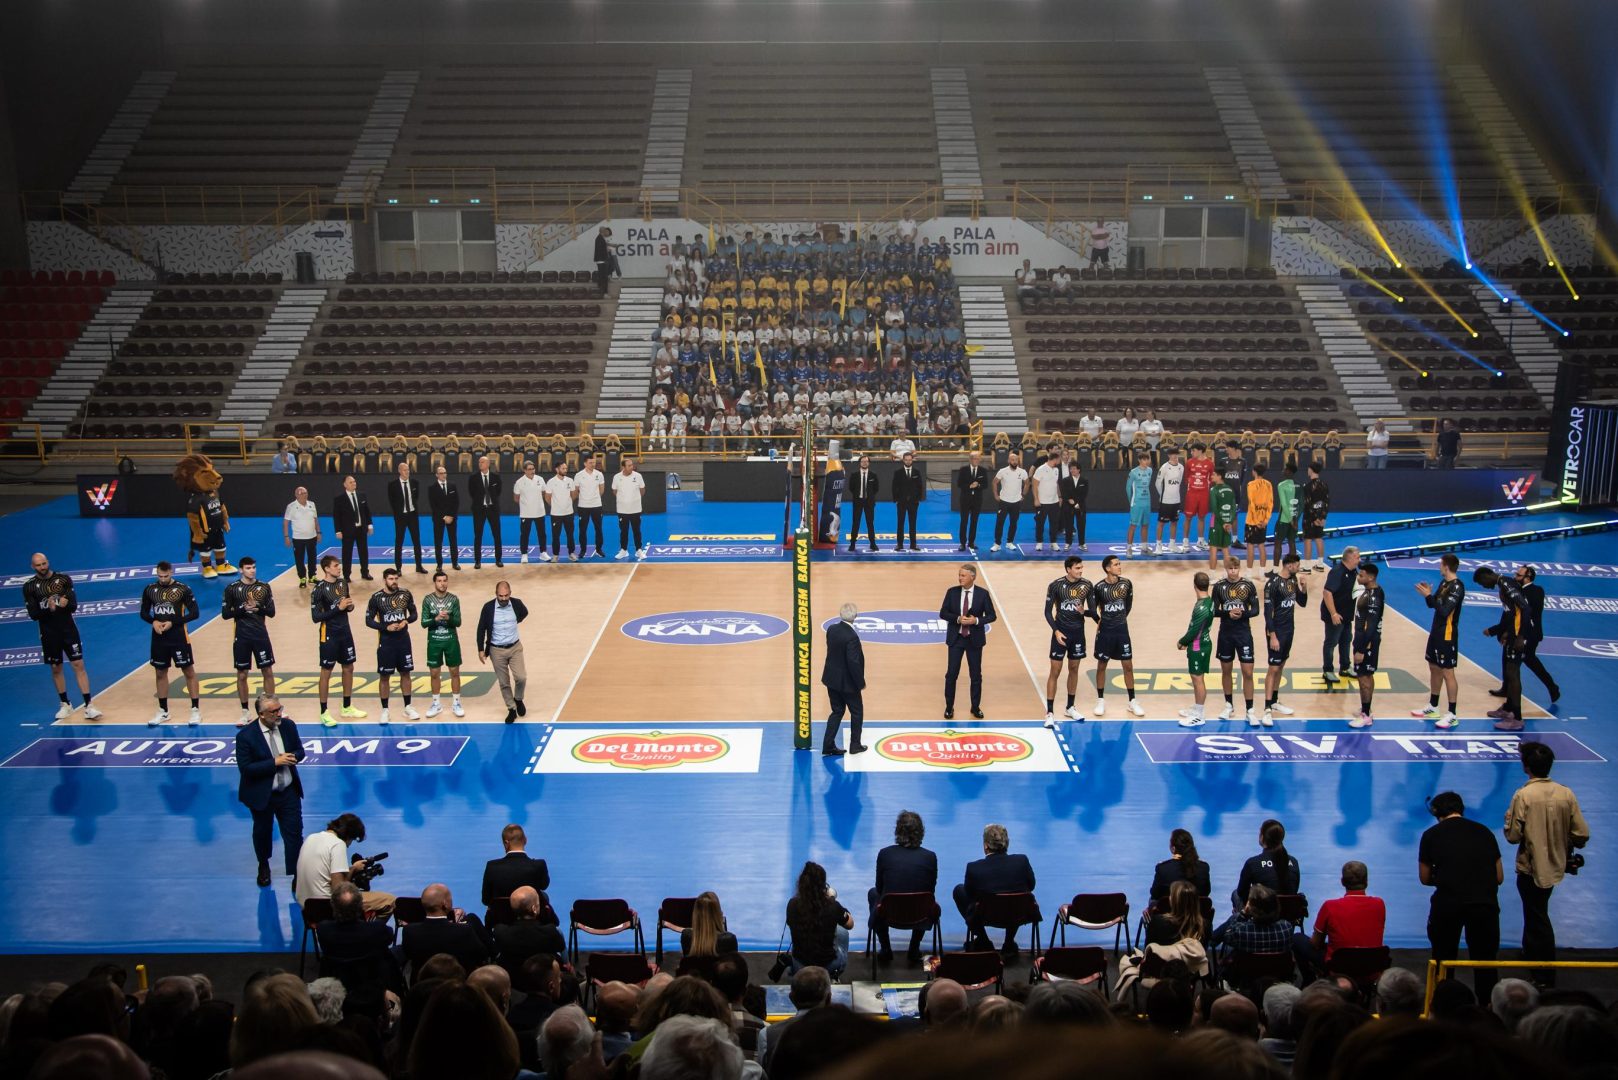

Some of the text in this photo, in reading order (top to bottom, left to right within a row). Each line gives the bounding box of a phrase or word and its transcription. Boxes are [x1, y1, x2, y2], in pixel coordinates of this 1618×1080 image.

[627, 228, 669, 241] PALA
[954, 227, 995, 240] PALA
[984, 242, 1019, 256] aim
[1561, 407, 1585, 503] VETROCAR
[1418, 557, 1618, 574] MAXIMILIA
[154, 606, 176, 615] RANA
[1104, 603, 1124, 612] RANA
[383, 613, 406, 622] RANA
[638, 624, 770, 636] RANA
[797, 538, 810, 738] CREDEM BANCA CREDEM BANCA
[65, 739, 431, 755] AUTOAM 9
[587, 742, 718, 753] Del Monte
[890, 741, 1020, 752] Del Monte
[620, 752, 676, 761] Quality
[927, 751, 984, 760] Quality
